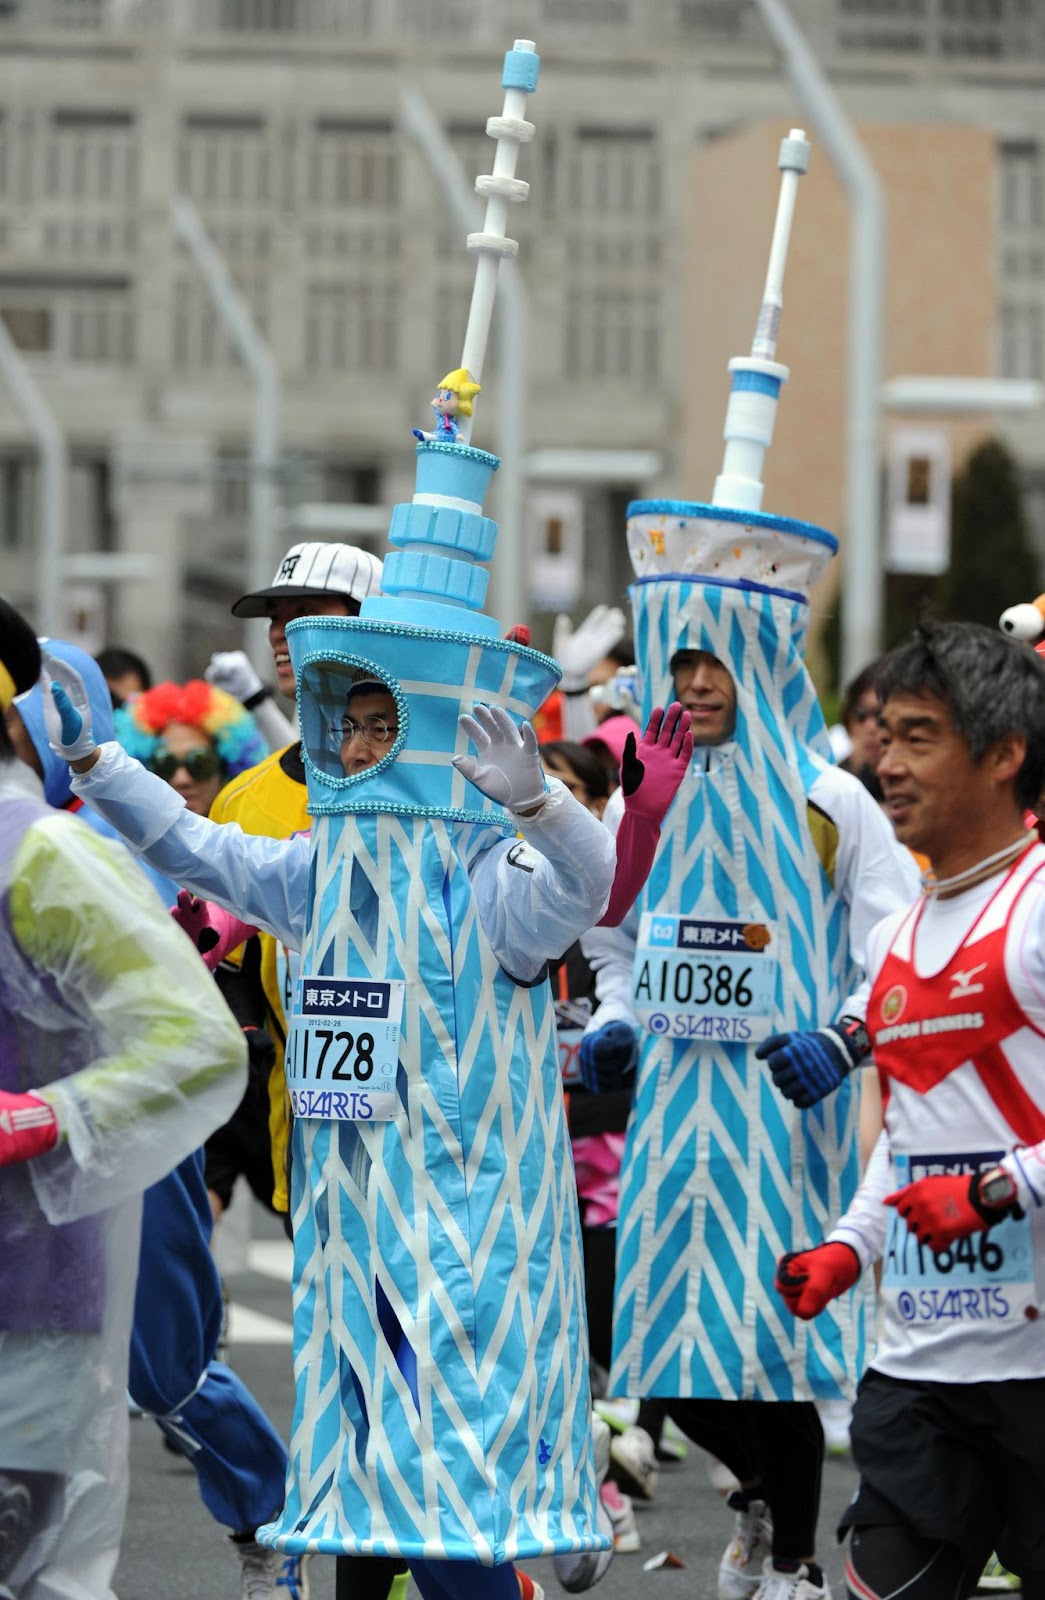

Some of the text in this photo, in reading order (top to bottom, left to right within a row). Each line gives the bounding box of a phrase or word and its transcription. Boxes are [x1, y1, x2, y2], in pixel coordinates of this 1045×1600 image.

[682, 926, 746, 946] 東京メト
[635, 960, 753, 1007] A10386
[305, 988, 384, 1009] 東京メトロ
[308, 1019, 342, 1027] 2012-02-26
[673, 1014, 752, 1040] STARTS
[286, 1029, 375, 1082] A11728
[299, 1091, 373, 1119] STARTS
